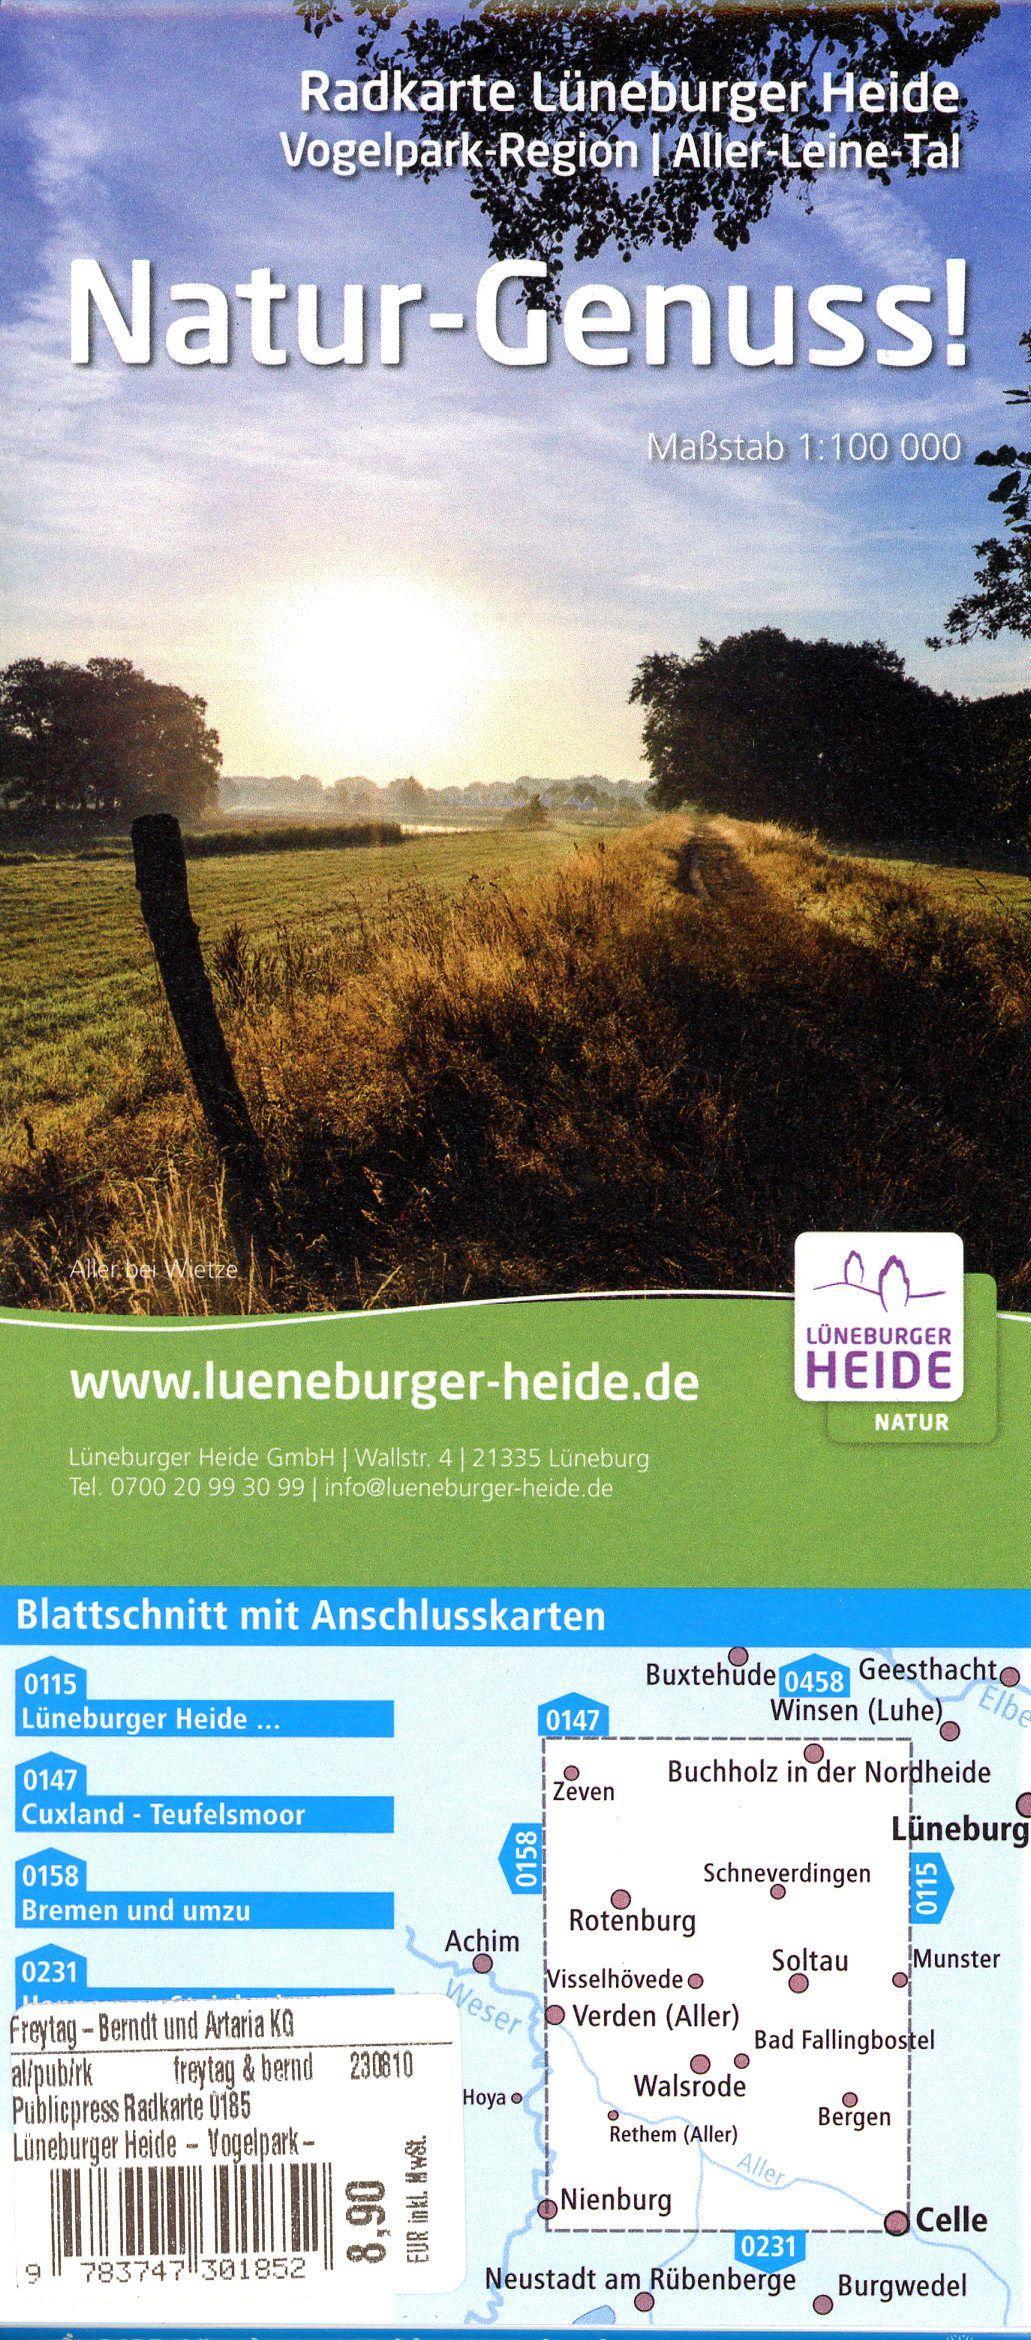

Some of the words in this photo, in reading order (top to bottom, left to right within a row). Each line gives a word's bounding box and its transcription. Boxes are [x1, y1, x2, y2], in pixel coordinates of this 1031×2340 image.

[300, 69, 514, 113] Radkarte
[532, 69, 806, 123] Lüneburger
[823, 69, 959, 113] Heide
[279, 131, 638, 177] Vogelpark-Region
[673, 131, 961, 169] Aller-Leine-Tal
[69, 258, 967, 368] Natur-Genuss!
[647, 431, 784, 463] Maßstab
[799, 431, 888, 463] 1:100
[901, 431, 961, 463] 000
[70, 1259, 118, 1279] Aller
[126, 1259, 156, 1279] bei
[164, 1259, 241, 1279] Wietze
[807, 1324, 951, 1345] LÜNEBURGER
[807, 1351, 951, 1389] HEIDE
[70, 1360, 699, 1408] www.lueneburger-heide.de
[875, 1414, 949, 1431] NATUR
[69, 1446, 191, 1472] Lüneburger
[200, 1446, 258, 1467] Heide
[267, 1446, 334, 1467] GmbH
[355, 1446, 431, 1467] Wallstr.
[439, 1447, 452, 1467] 4
[473, 1447, 540, 1467] 21335
[549, 1446, 649, 1472] Lüneburg
[70, 1477, 102, 1497] Tel.
[111, 1477, 165, 1497] 0700
[174, 1477, 199, 1497] 20
[208, 1477, 234, 1497] 99
[242, 1477, 270, 1497] 30
[277, 1477, 305, 1497] 99
[325, 1477, 613, 1502] info@lueneburger-heide.de
[16, 1599, 230, 1631] Blattschnitt
[241, 1599, 298, 1631] mit
[312, 1599, 605, 1631] Anschlusskarten
[646, 1663, 776, 1688] Buxtehude
[859, 1656, 997, 1681] Geesthacht
[24, 1674, 77, 1695] 0115
[784, 1672, 844, 1693] 0458
[770, 1699, 858, 1722] Winsen
[868, 1697, 943, 1726] (Luhe)
[979, 1683, 1031, 1728] Elbe
[22, 1706, 167, 1732] Lüneburger
[176, 1706, 248, 1731] Heide
[546, 1710, 600, 1731] 0147
[23, 1770, 77, 1791] 0147
[668, 1761, 778, 1784] Buchholz
[787, 1761, 808, 1784] in
[817, 1761, 856, 1784] der
[865, 1761, 991, 1784] Nordheide
[553, 1782, 615, 1801] Zeven
[22, 1803, 125, 1826] Cuxland
[152, 1803, 306, 1826] Teufelsmoor
[892, 1816, 1029, 1848] Lüneburg
[515, 1830, 537, 1888] 0158
[22, 1865, 80, 1887] 0158
[703, 1862, 871, 1885] Schneverdingen
[915, 1862, 937, 1915] 0115
[22, 1899, 119, 1923] Bremen
[127, 1899, 175, 1923] und
[183, 1904, 250, 1923] umzu
[569, 1908, 696, 1937] Rotenburg
[445, 1929, 520, 1953] Achim
[772, 1949, 849, 1973] Soltau
[913, 1949, 1000, 1969] Munster
[22, 1962, 77, 1983] 0231
[547, 1969, 684, 1990] Visselhövede
[447, 1977, 522, 2035] Weser
[572, 2005, 656, 2028] Verden
[665, 2003, 740, 2032] (Aller)
[10, 2015, 77, 2050] Freytag
[99, 2012, 157, 2043] Berndt
[164, 2010, 198, 2041] und
[205, 2009, 265, 2039] Artaria
[754, 2029, 794, 2050] Bad
[801, 2029, 935, 2055] Fallingbostel
[173, 2056, 235, 2089] freytag
[243, 2055, 254, 2082] &
[262, 2053, 313, 2082] bernd
[462, 2088, 507, 2110] Hoya
[633, 2074, 747, 2098] Walsrode
[12, 2096, 119, 2130] Publicpress
[124, 2093, 203, 2123] Radkarte
[209, 2090, 250, 2120] 0185
[818, 2107, 891, 2131] Bergen
[13, 2131, 119, 2166] Lüneburger
[125, 2130, 177, 2160] Heide
[609, 2125, 677, 2143] Rethem
[684, 2124, 738, 2146] (Aller)
[405, 2134, 428, 2183] MwSt.
[737, 2152, 786, 2185] Aller
[406, 2189, 428, 2224] inkl.
[560, 2188, 672, 2216] Nienburg
[345, 2180, 391, 2264] 8,90
[915, 2207, 988, 2232] Celle
[407, 2230, 429, 2264] EUR
[741, 2235, 797, 2257] 0231
[25, 2263, 41, 2284] 9
[80, 2261, 184, 2283] 783747
[202, 2257, 306, 2280] 301852
[485, 2267, 596, 2291] Neustadt
[605, 2274, 642, 2291] am
[650, 2267, 796, 2296] Rübenberge
[838, 2274, 967, 2301] Burgwedel
